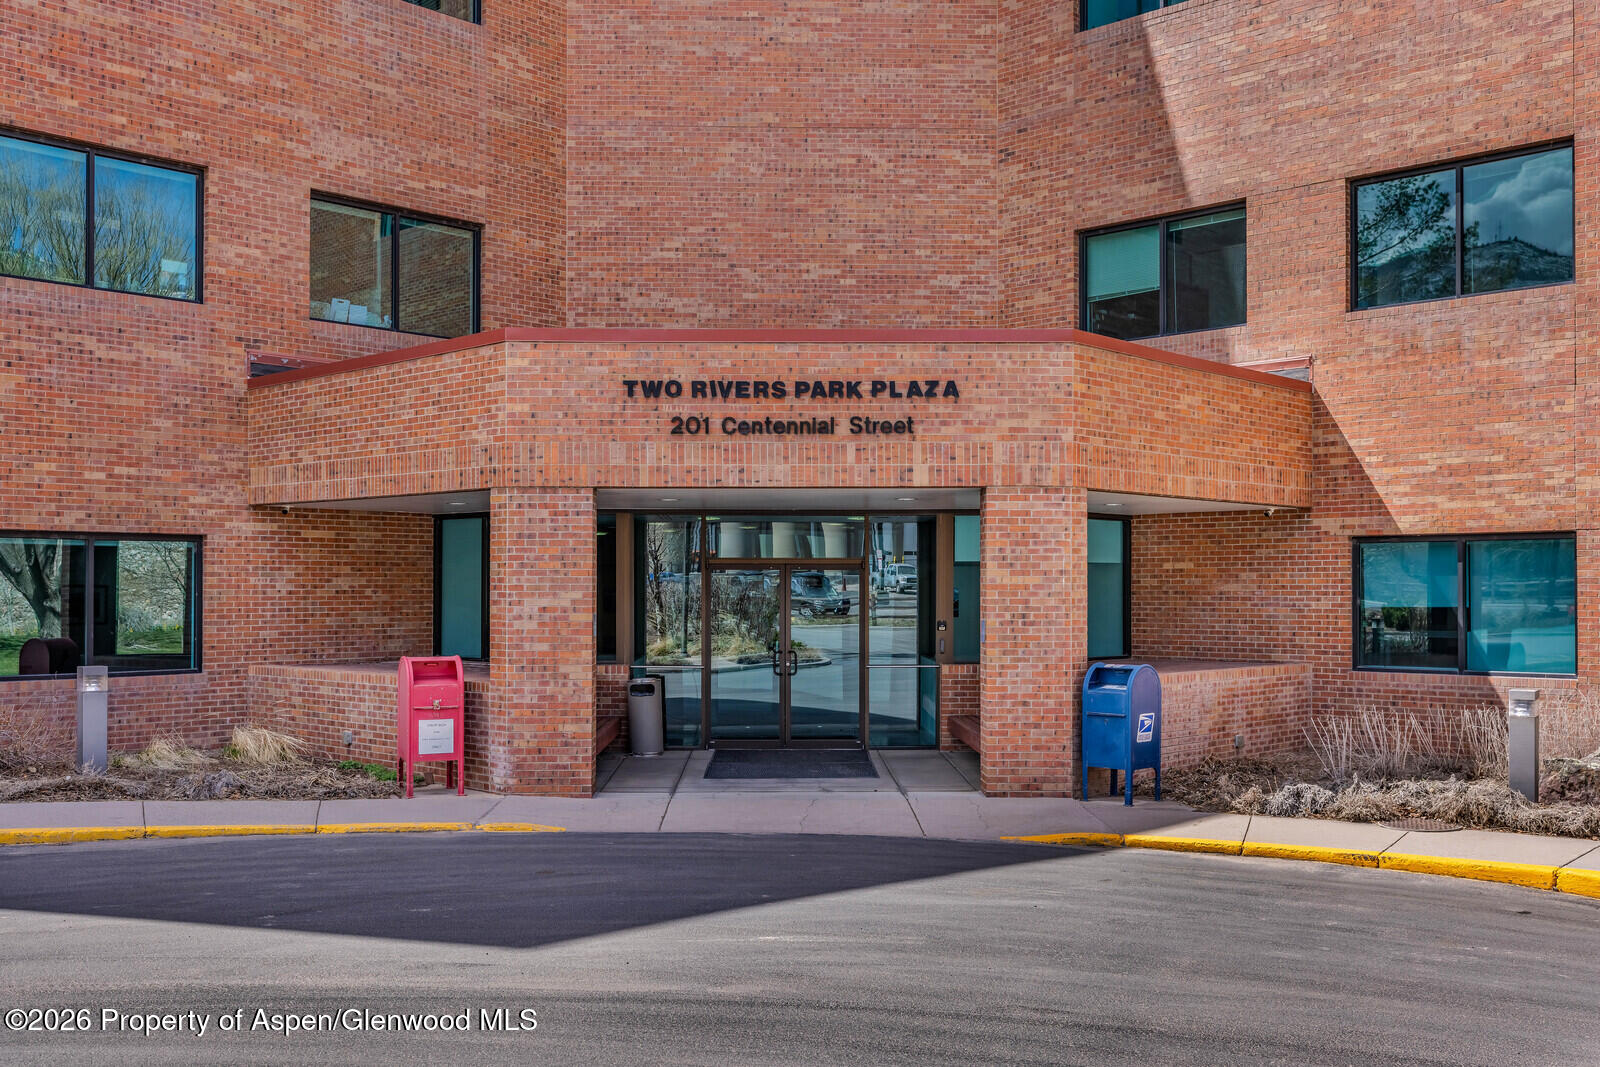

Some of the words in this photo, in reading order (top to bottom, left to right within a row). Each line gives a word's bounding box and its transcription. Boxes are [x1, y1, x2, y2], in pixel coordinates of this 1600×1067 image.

[623, 380, 683, 398] TWO
[691, 380, 787, 398] RIVERS
[794, 380, 863, 399] PARK
[871, 380, 960, 398] PLAZA
[670, 416, 710, 435] 201
[721, 416, 835, 435] Centennial
[849, 416, 915, 435] Street
